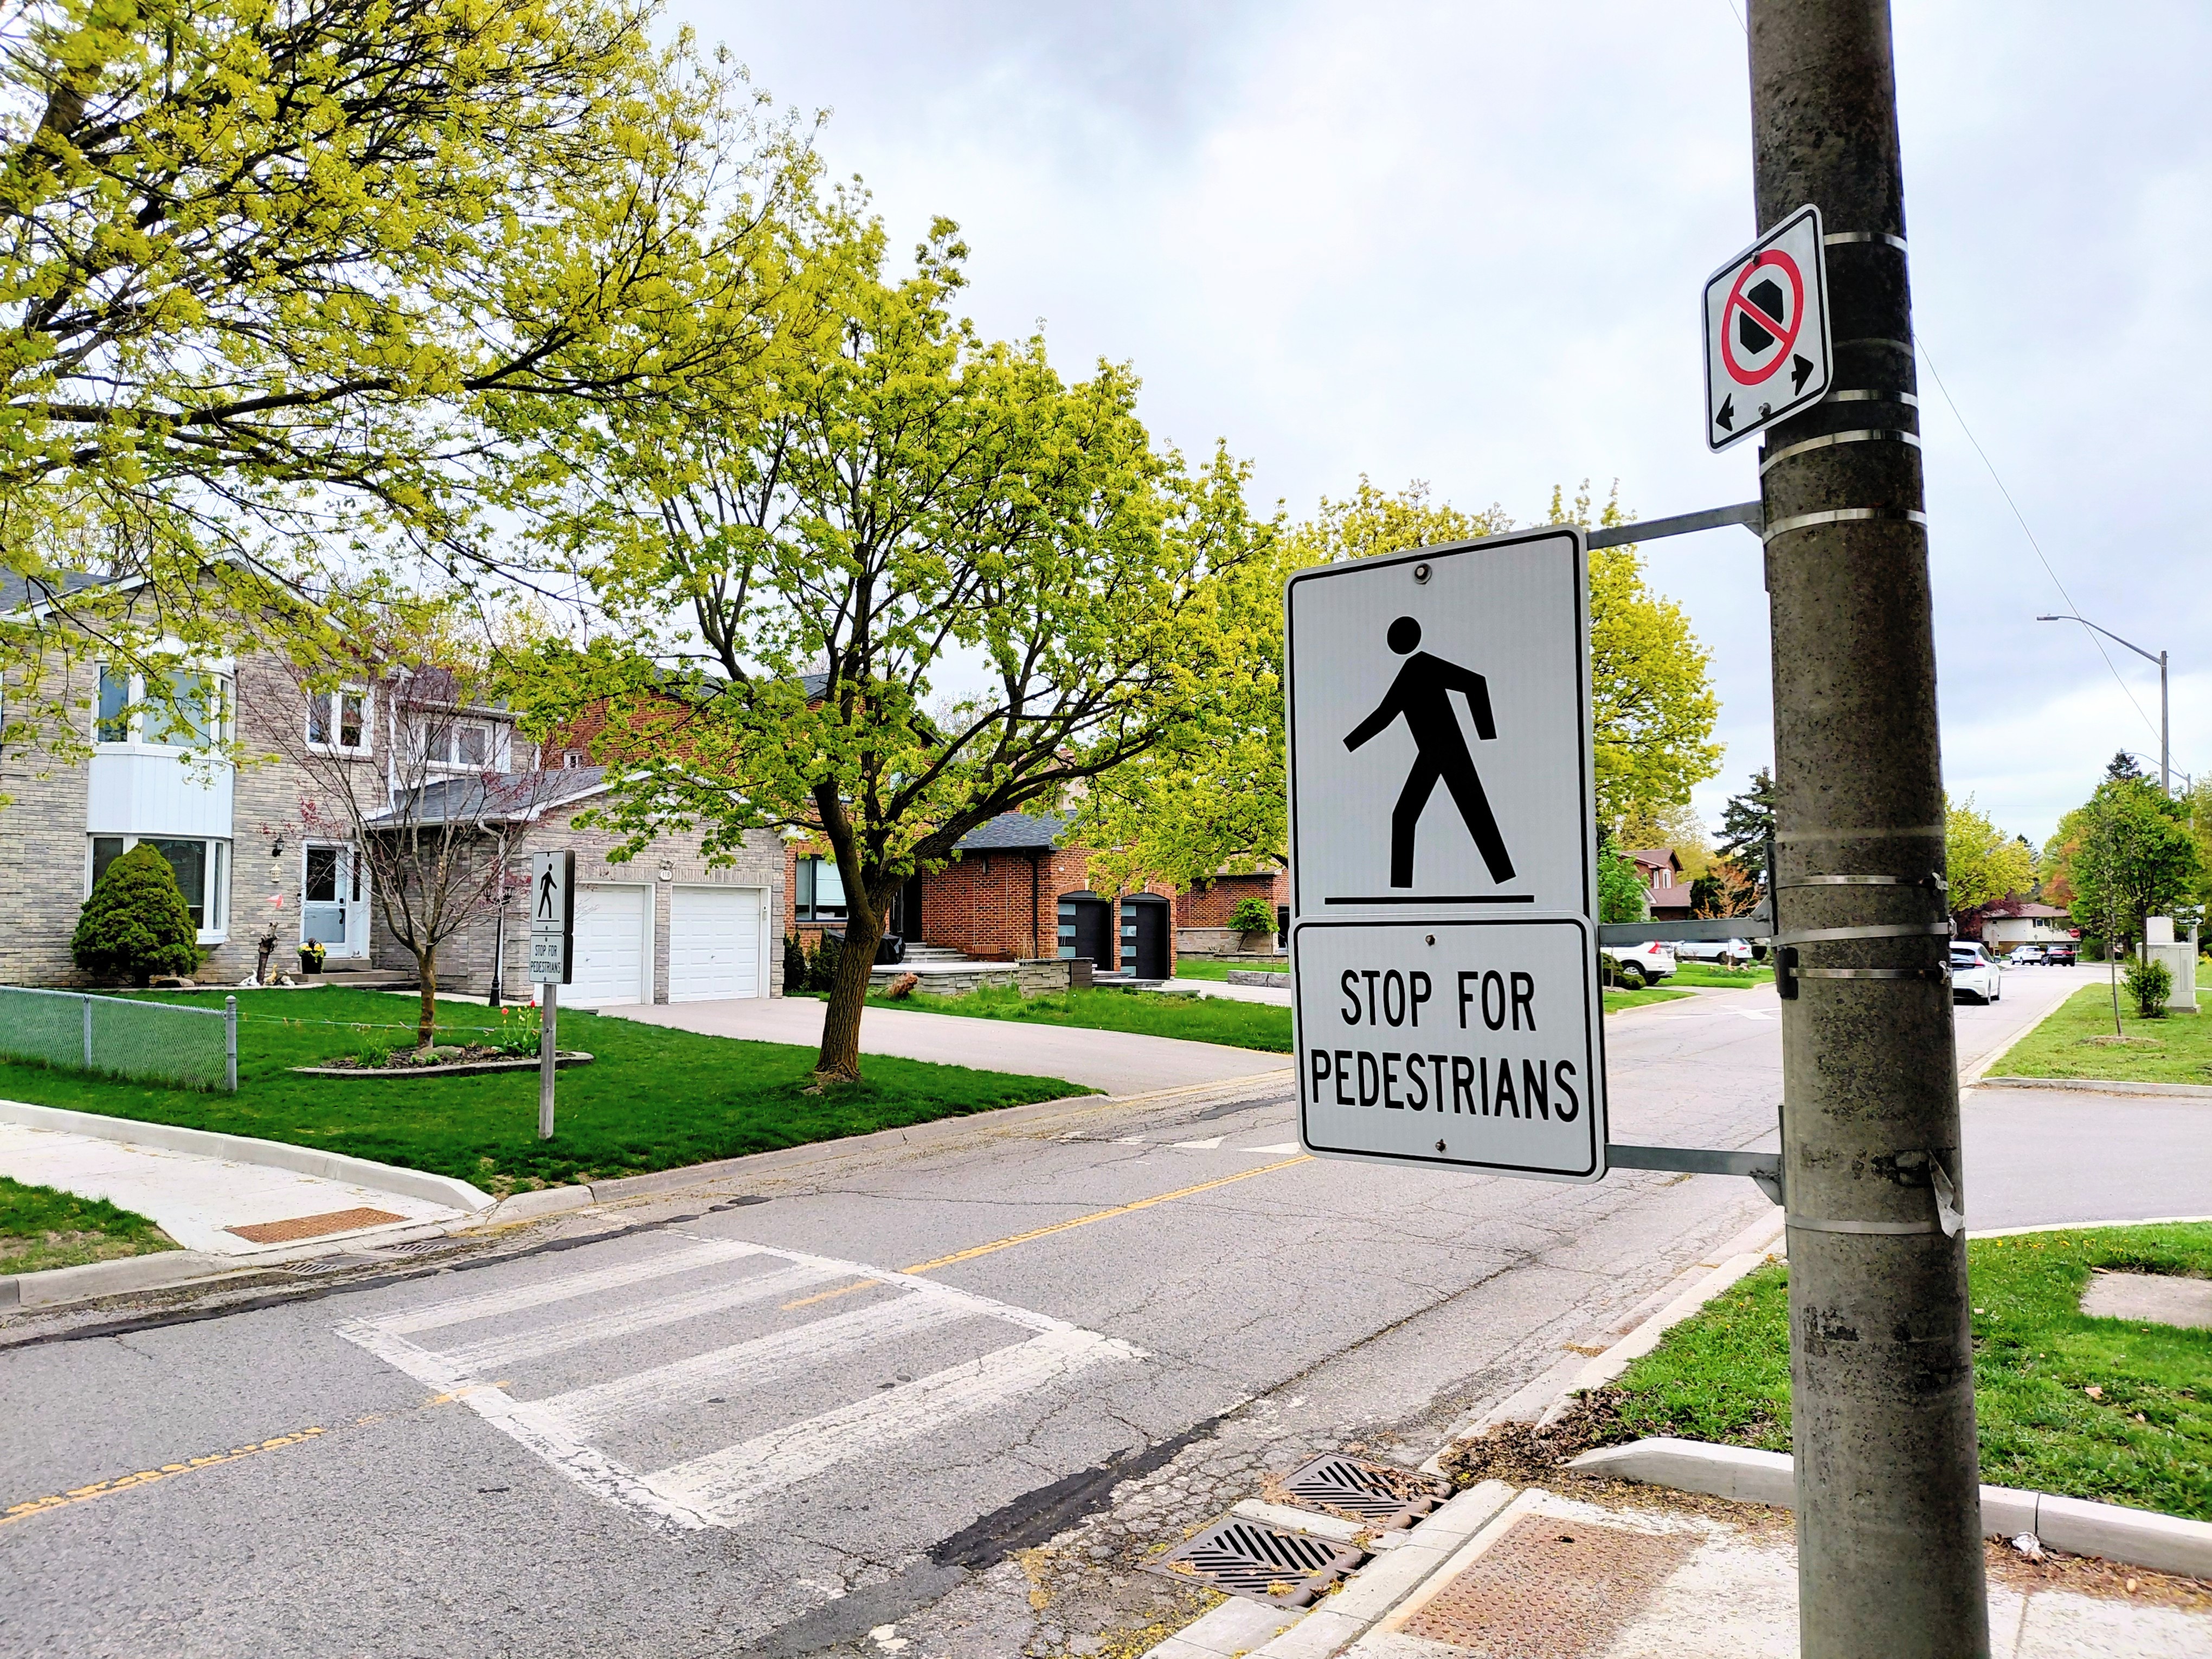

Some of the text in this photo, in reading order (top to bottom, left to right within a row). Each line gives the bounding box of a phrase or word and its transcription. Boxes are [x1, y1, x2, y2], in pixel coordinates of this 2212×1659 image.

[531, 961, 561, 974] PEDESTRIANS
[535, 944, 557, 957] STOP FOR
[1341, 969, 1536, 1031] STOP FOR
[1311, 1049, 1579, 1122] PEDESTRIANS
